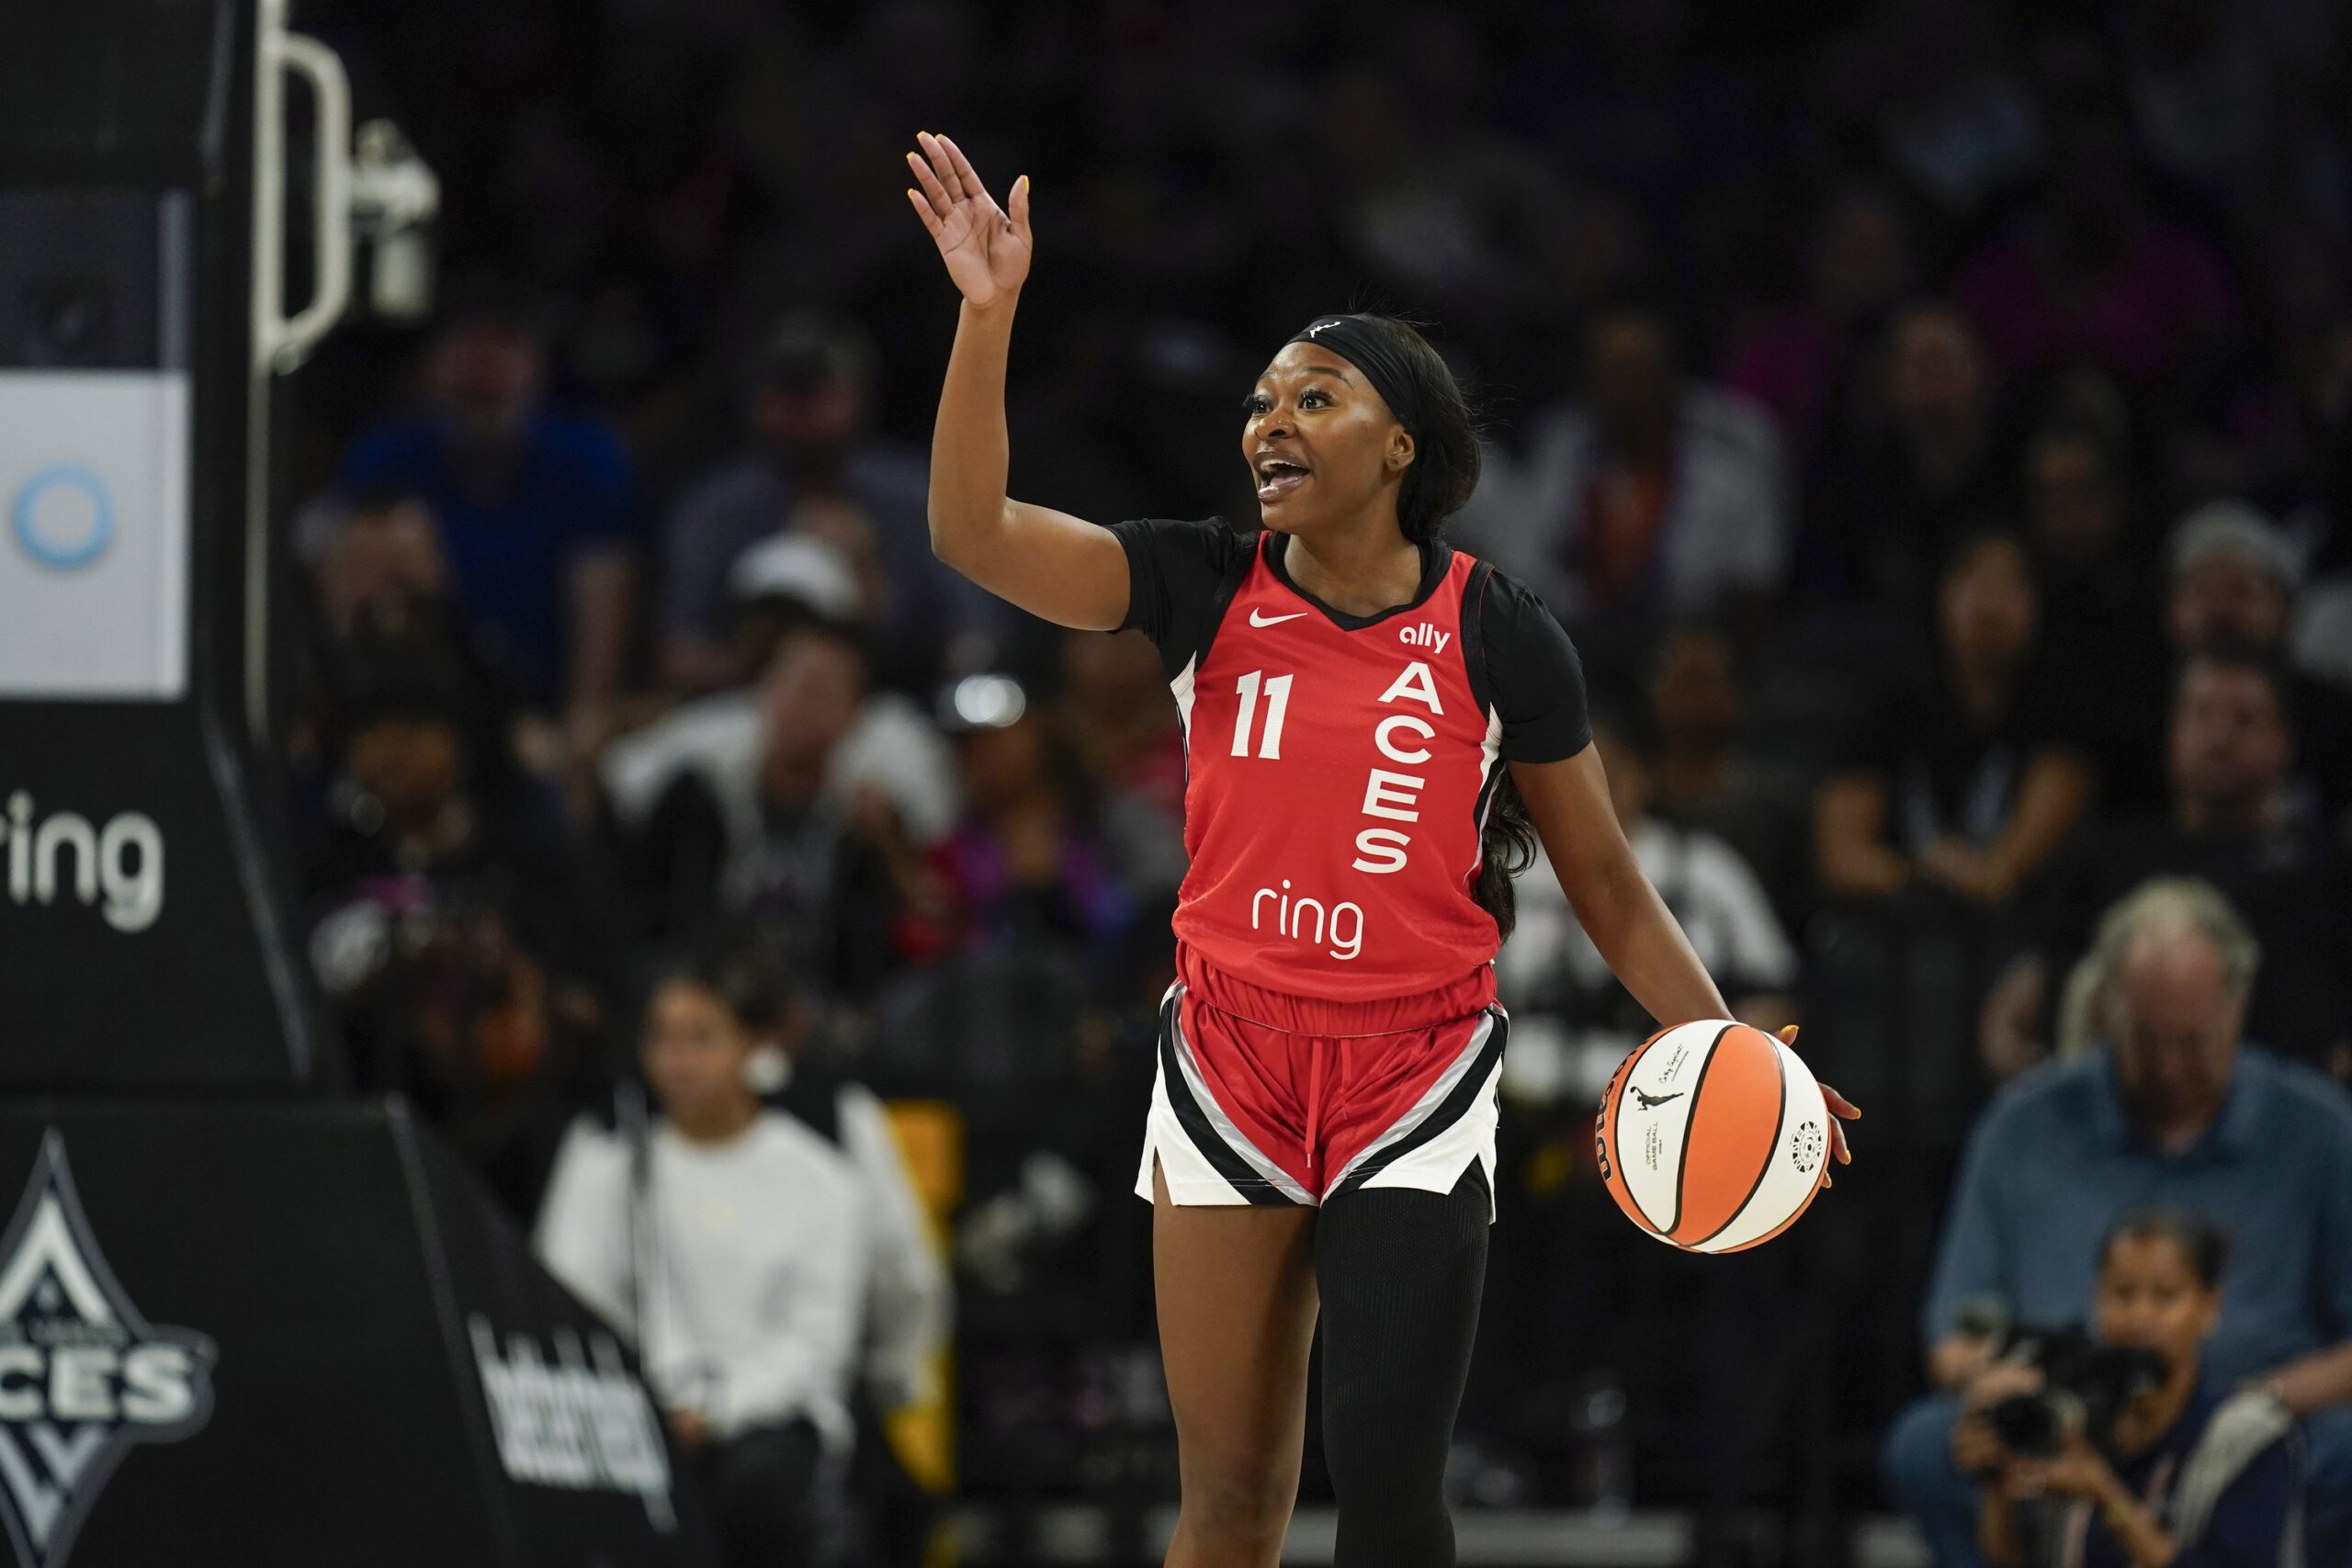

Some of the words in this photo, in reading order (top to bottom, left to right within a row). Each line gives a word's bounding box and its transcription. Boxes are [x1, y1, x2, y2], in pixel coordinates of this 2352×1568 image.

[1399, 622, 1451, 654] ally
[1230, 670, 1294, 760] 11
[1351, 661, 1444, 874] ACES
[0, 788, 164, 933] ing
[1252, 879, 1363, 960] ring
